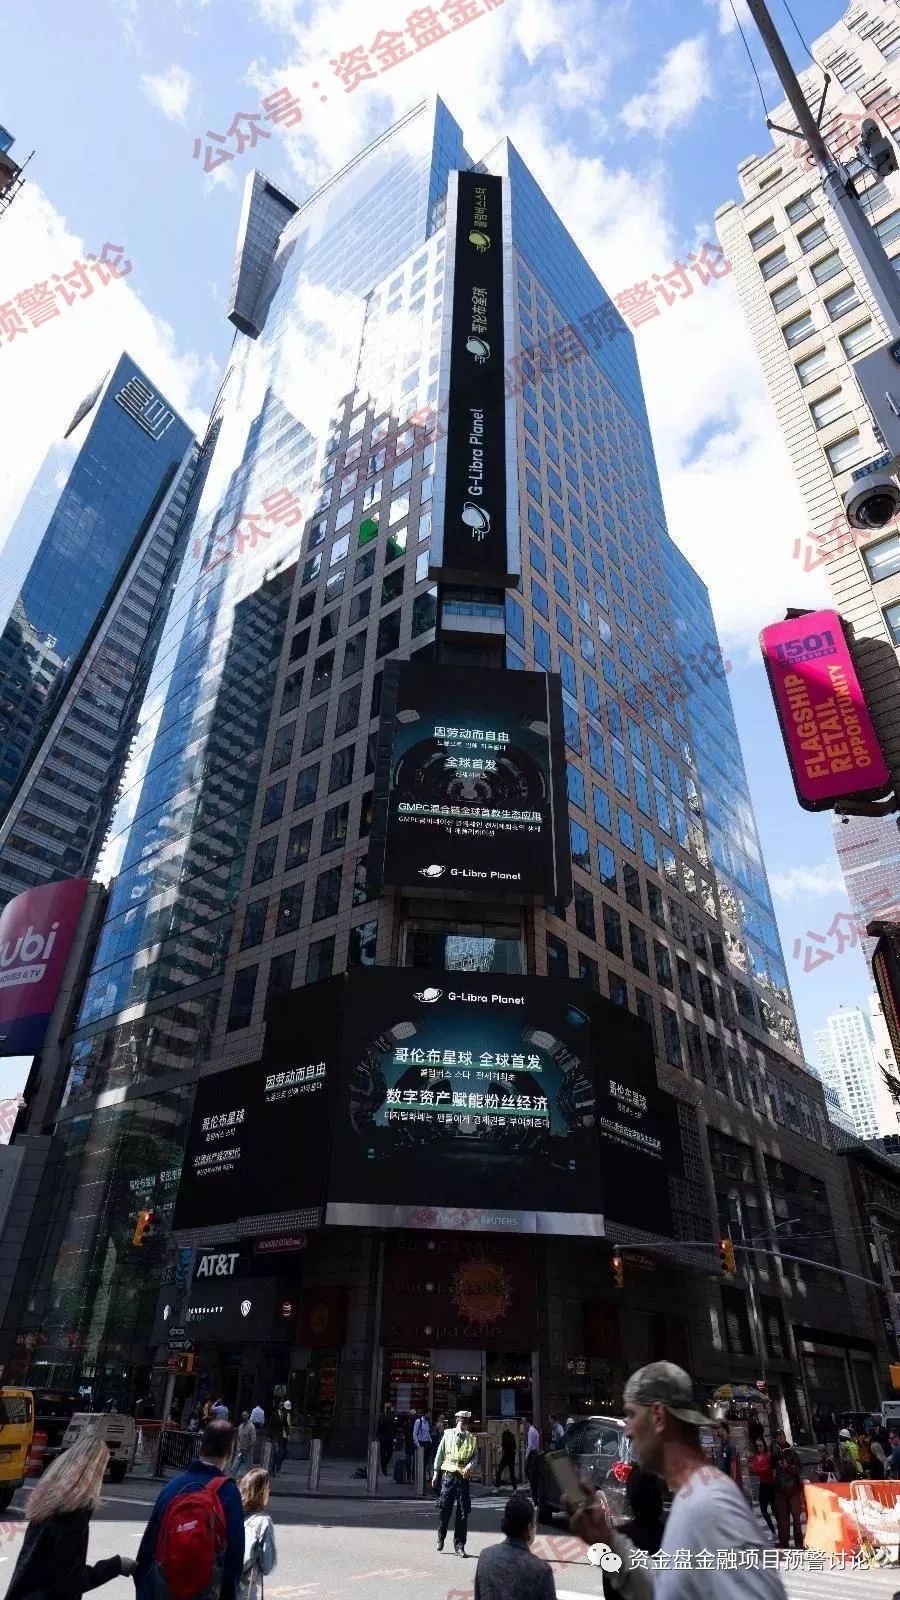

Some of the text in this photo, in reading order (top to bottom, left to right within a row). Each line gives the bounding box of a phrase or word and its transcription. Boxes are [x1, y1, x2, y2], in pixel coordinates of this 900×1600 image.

[471, 286, 488, 333] 哥伦布星球
[468, 408, 484, 496] G-Libra Planet
[775, 630, 834, 661] 1501
[784, 673, 829, 779] FLAGSHIP
[828, 664, 872, 768] OPPORTUNITY
[434, 726, 510, 743] 因劳动而自由
[815, 697, 854, 774] RETAIL
[444, 756, 498, 771] 全球首发
[450, 868, 521, 881] G-Libra Planet
[0, 921, 60, 968] ubi
[30, 968, 41, 979] TV
[448, 991, 525, 1006] G-Libra Planet
[394, 1047, 541, 1070] 哥伦布星球 全球首发
[265, 1061, 326, 1090] 因劳动而自由
[386, 1087, 549, 1112] 数字资产赋能粉丝经济
[201, 1108, 246, 1131] 哥伦布星球
[197, 1253, 240, 1277] AT&T
